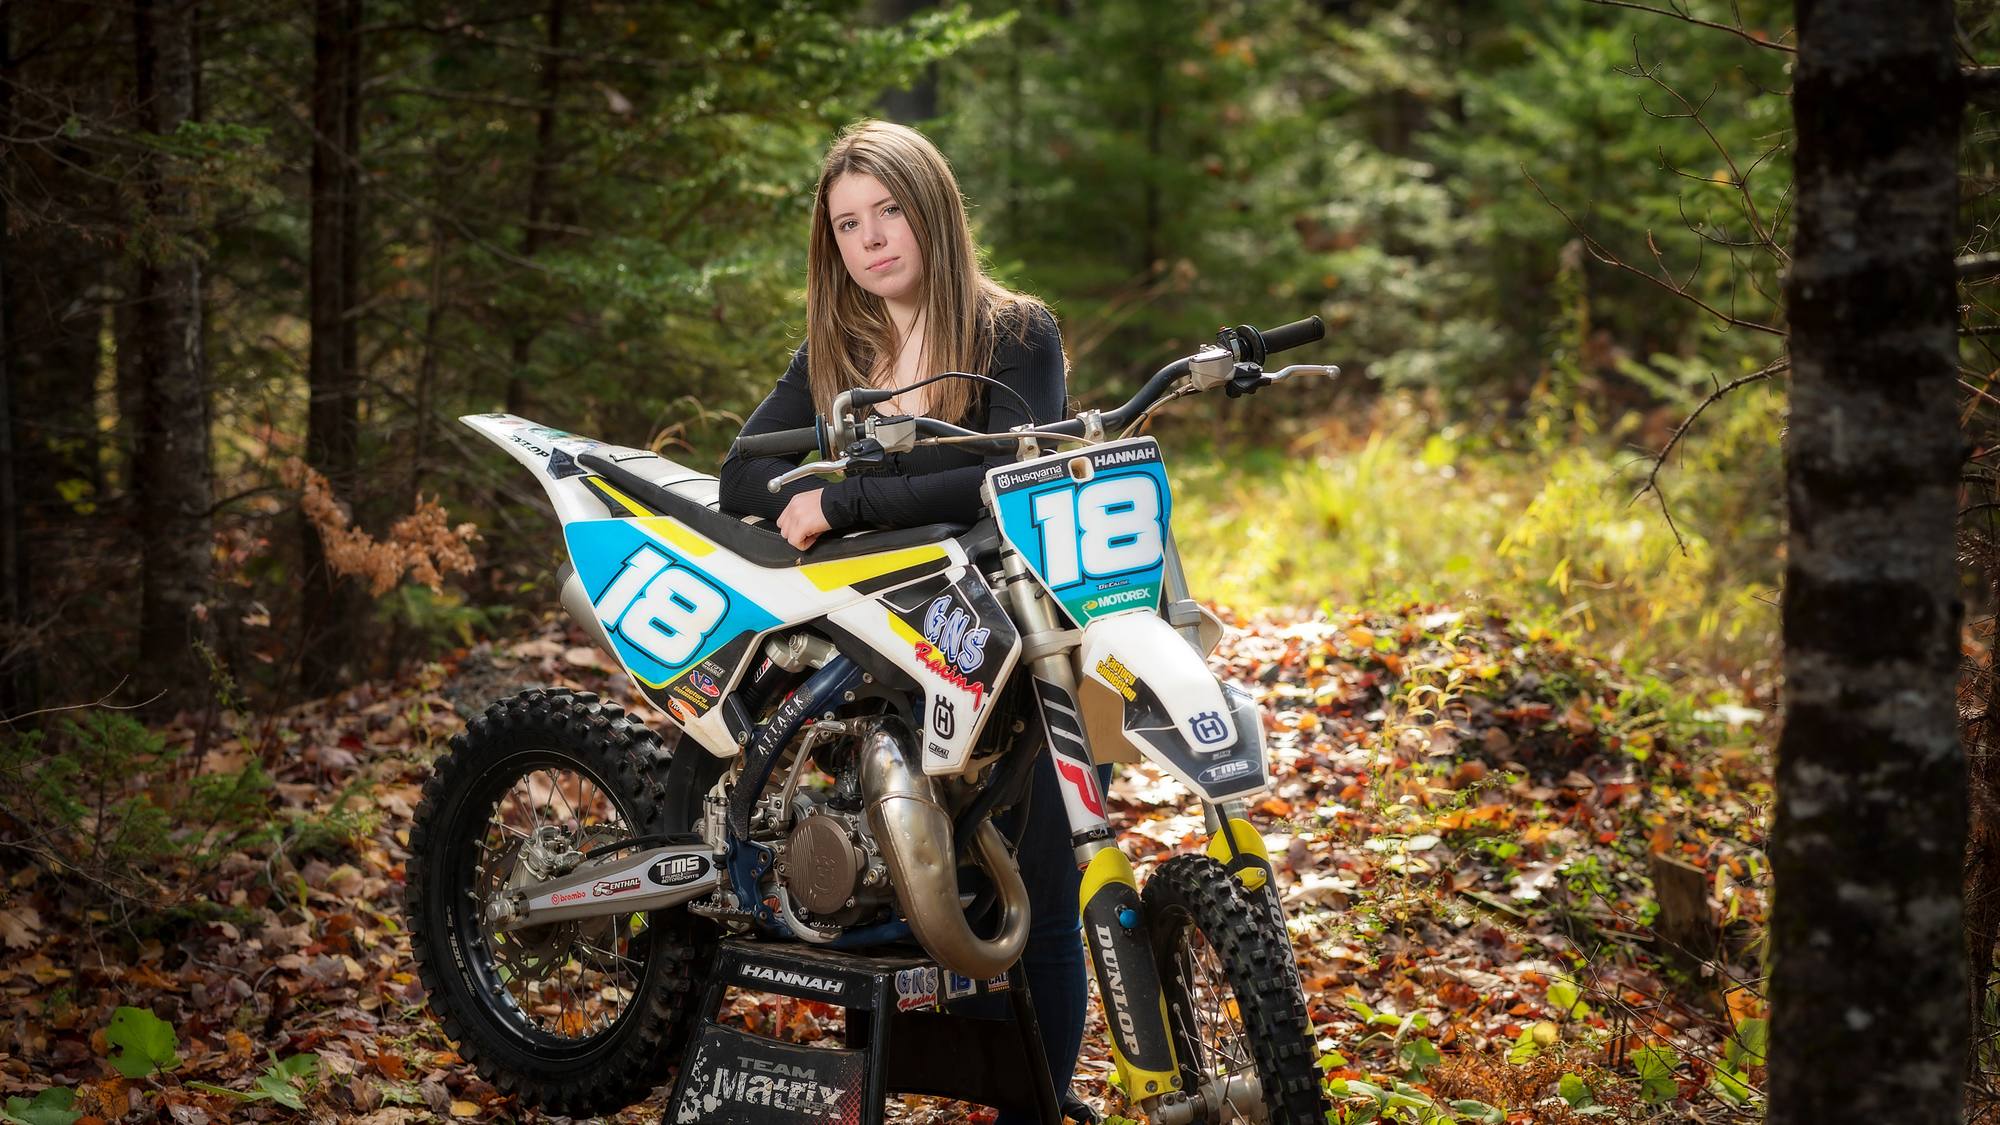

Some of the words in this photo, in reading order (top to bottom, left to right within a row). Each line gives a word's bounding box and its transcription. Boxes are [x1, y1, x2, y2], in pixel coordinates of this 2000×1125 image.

[1094, 448, 1156, 467] HANNAH
[1010, 463, 1062, 485] Husqvarna
[1032, 474, 1163, 589] 18
[594, 543, 729, 667] 18
[1098, 588, 1151, 607] MOTOREX
[924, 595, 990, 674] GNS
[690, 670, 713, 690] VP
[915, 641, 984, 712] Racing
[1096, 660, 1137, 702] Connection
[1105, 654, 1137, 685] Factory
[758, 694, 804, 756] ATTACK
[1206, 760, 1249, 778] TMS
[657, 856, 700, 877] TMS
[593, 878, 641, 896] RENTHAL
[741, 964, 843, 993] HANNAH
[1095, 924, 1140, 1056] DUNLOP
[737, 1056, 816, 1080] TEAM
[712, 1067, 846, 1120] Matrix
